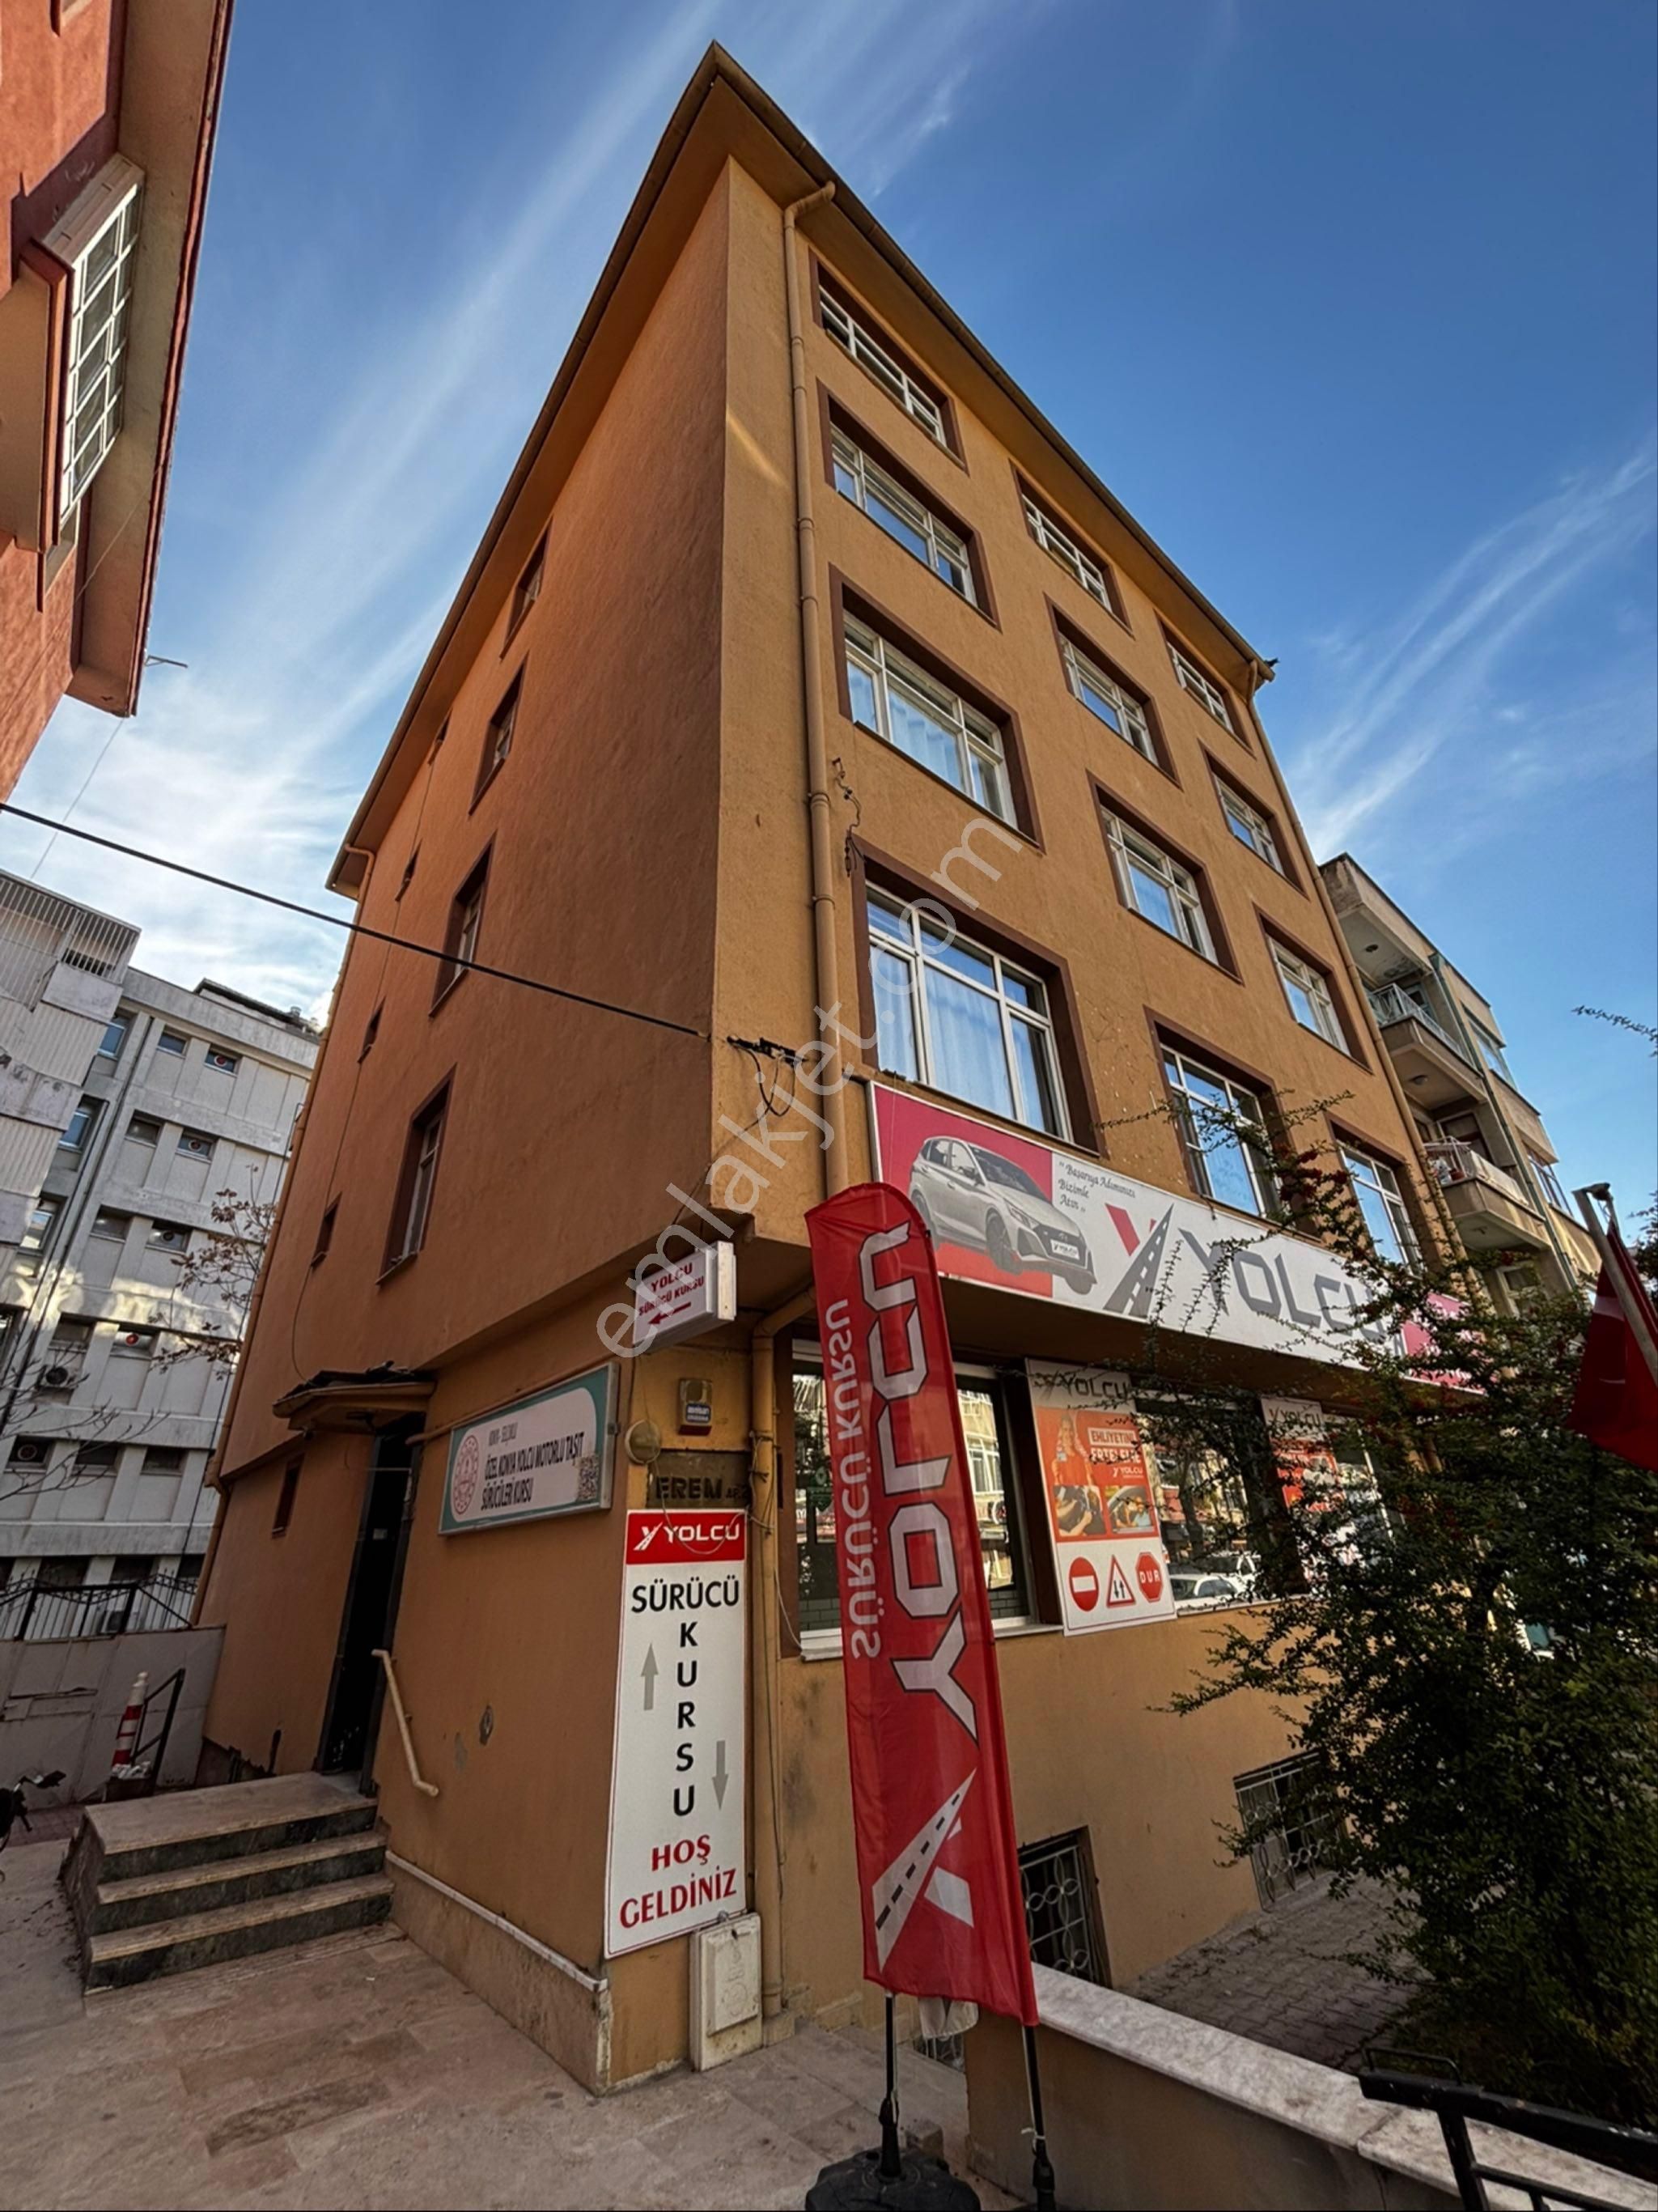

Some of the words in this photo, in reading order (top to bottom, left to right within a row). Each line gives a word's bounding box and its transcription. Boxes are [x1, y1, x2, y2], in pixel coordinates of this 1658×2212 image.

[655, 1475, 723, 1500] EREM
[664, 1523, 740, 1543] YOLCU
[1139, 1569, 1160, 1584] DUR
[631, 1574, 740, 1613] SÜRÜCÜ
[651, 1834, 711, 1866] HOŞ
[620, 1866, 737, 1929] GELDİNİZ
